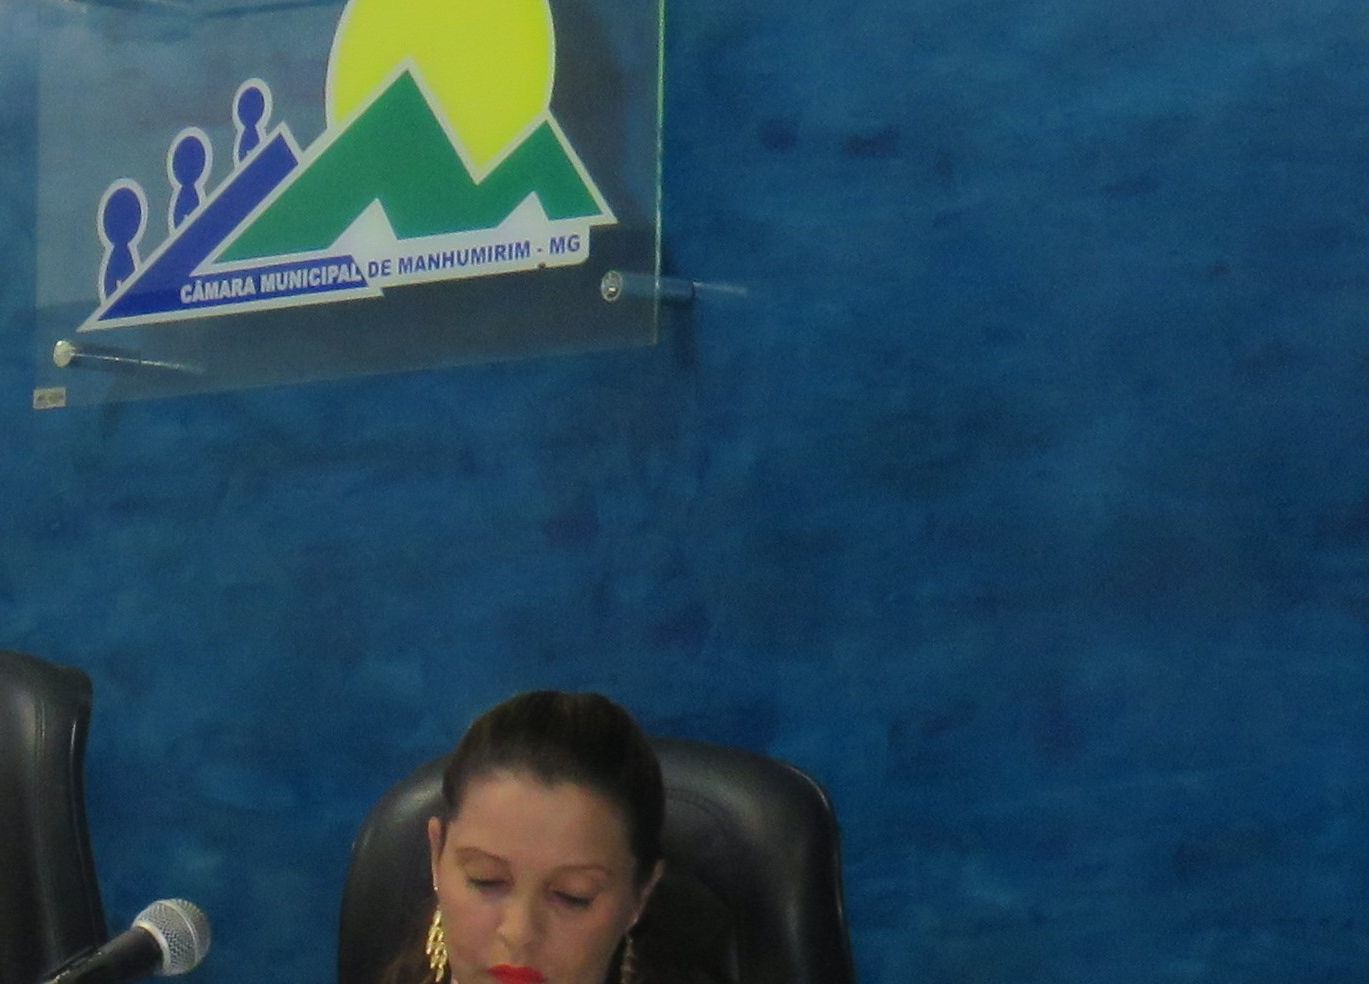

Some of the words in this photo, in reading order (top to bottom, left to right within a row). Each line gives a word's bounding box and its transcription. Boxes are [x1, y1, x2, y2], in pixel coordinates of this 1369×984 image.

[181, 280, 256, 303] CÂMARA
[260, 263, 362, 293] MUNICIPAL
[368, 259, 391, 278] DE
[398, 240, 531, 275] MANHUMIRIM
[549, 234, 580, 254] MG
